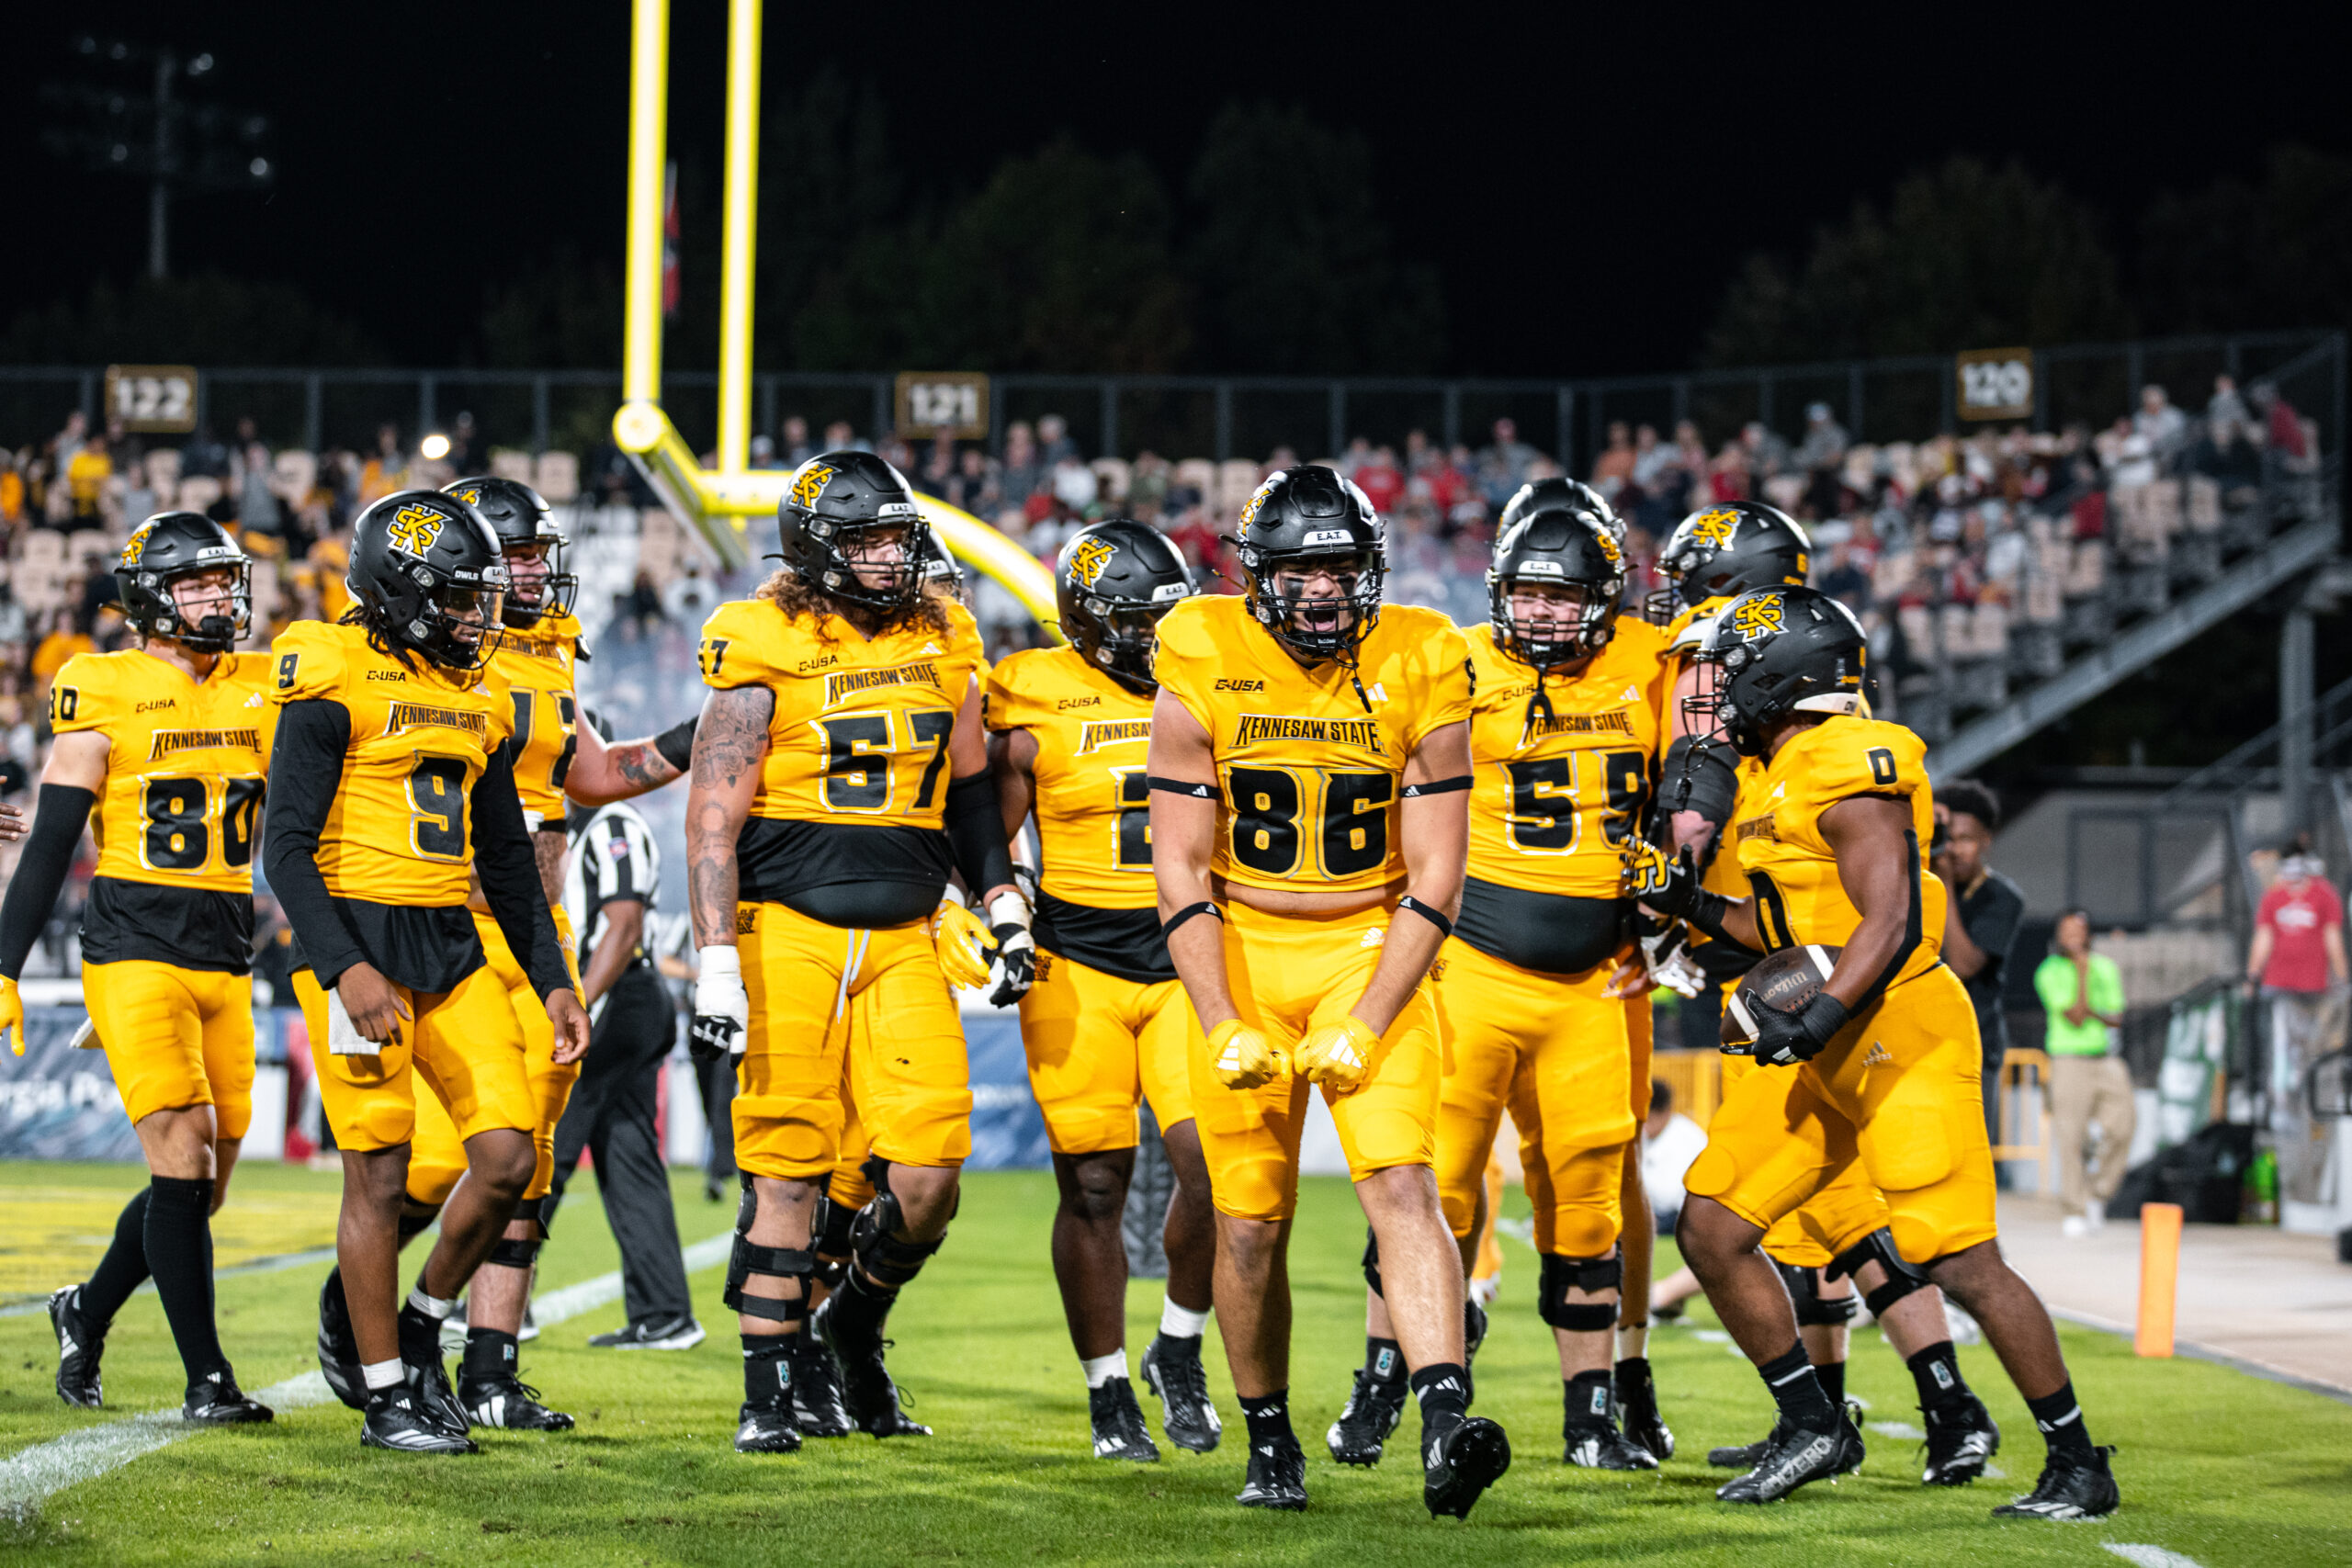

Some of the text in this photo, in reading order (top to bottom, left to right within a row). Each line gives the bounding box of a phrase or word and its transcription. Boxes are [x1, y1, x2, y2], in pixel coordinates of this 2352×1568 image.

[118, 378, 189, 420] 122
[1962, 360, 2029, 407] 120
[912, 384, 977, 424] 121
[279, 653, 299, 689] 9
[828, 662, 942, 704] KENNESAW STATE
[1502, 682, 1535, 702] C-US
[389, 704, 457, 731] KENNESAW
[1235, 716, 1382, 753] KENNESAW STATE
[1595, 711, 1634, 737] STATE
[152, 730, 262, 759] KENNESAW STATE
[819, 708, 955, 813] 57
[1868, 748, 1899, 786] 0
[142, 774, 266, 872] 80
[408, 752, 471, 861] 9
[1227, 763, 1395, 877] 86
